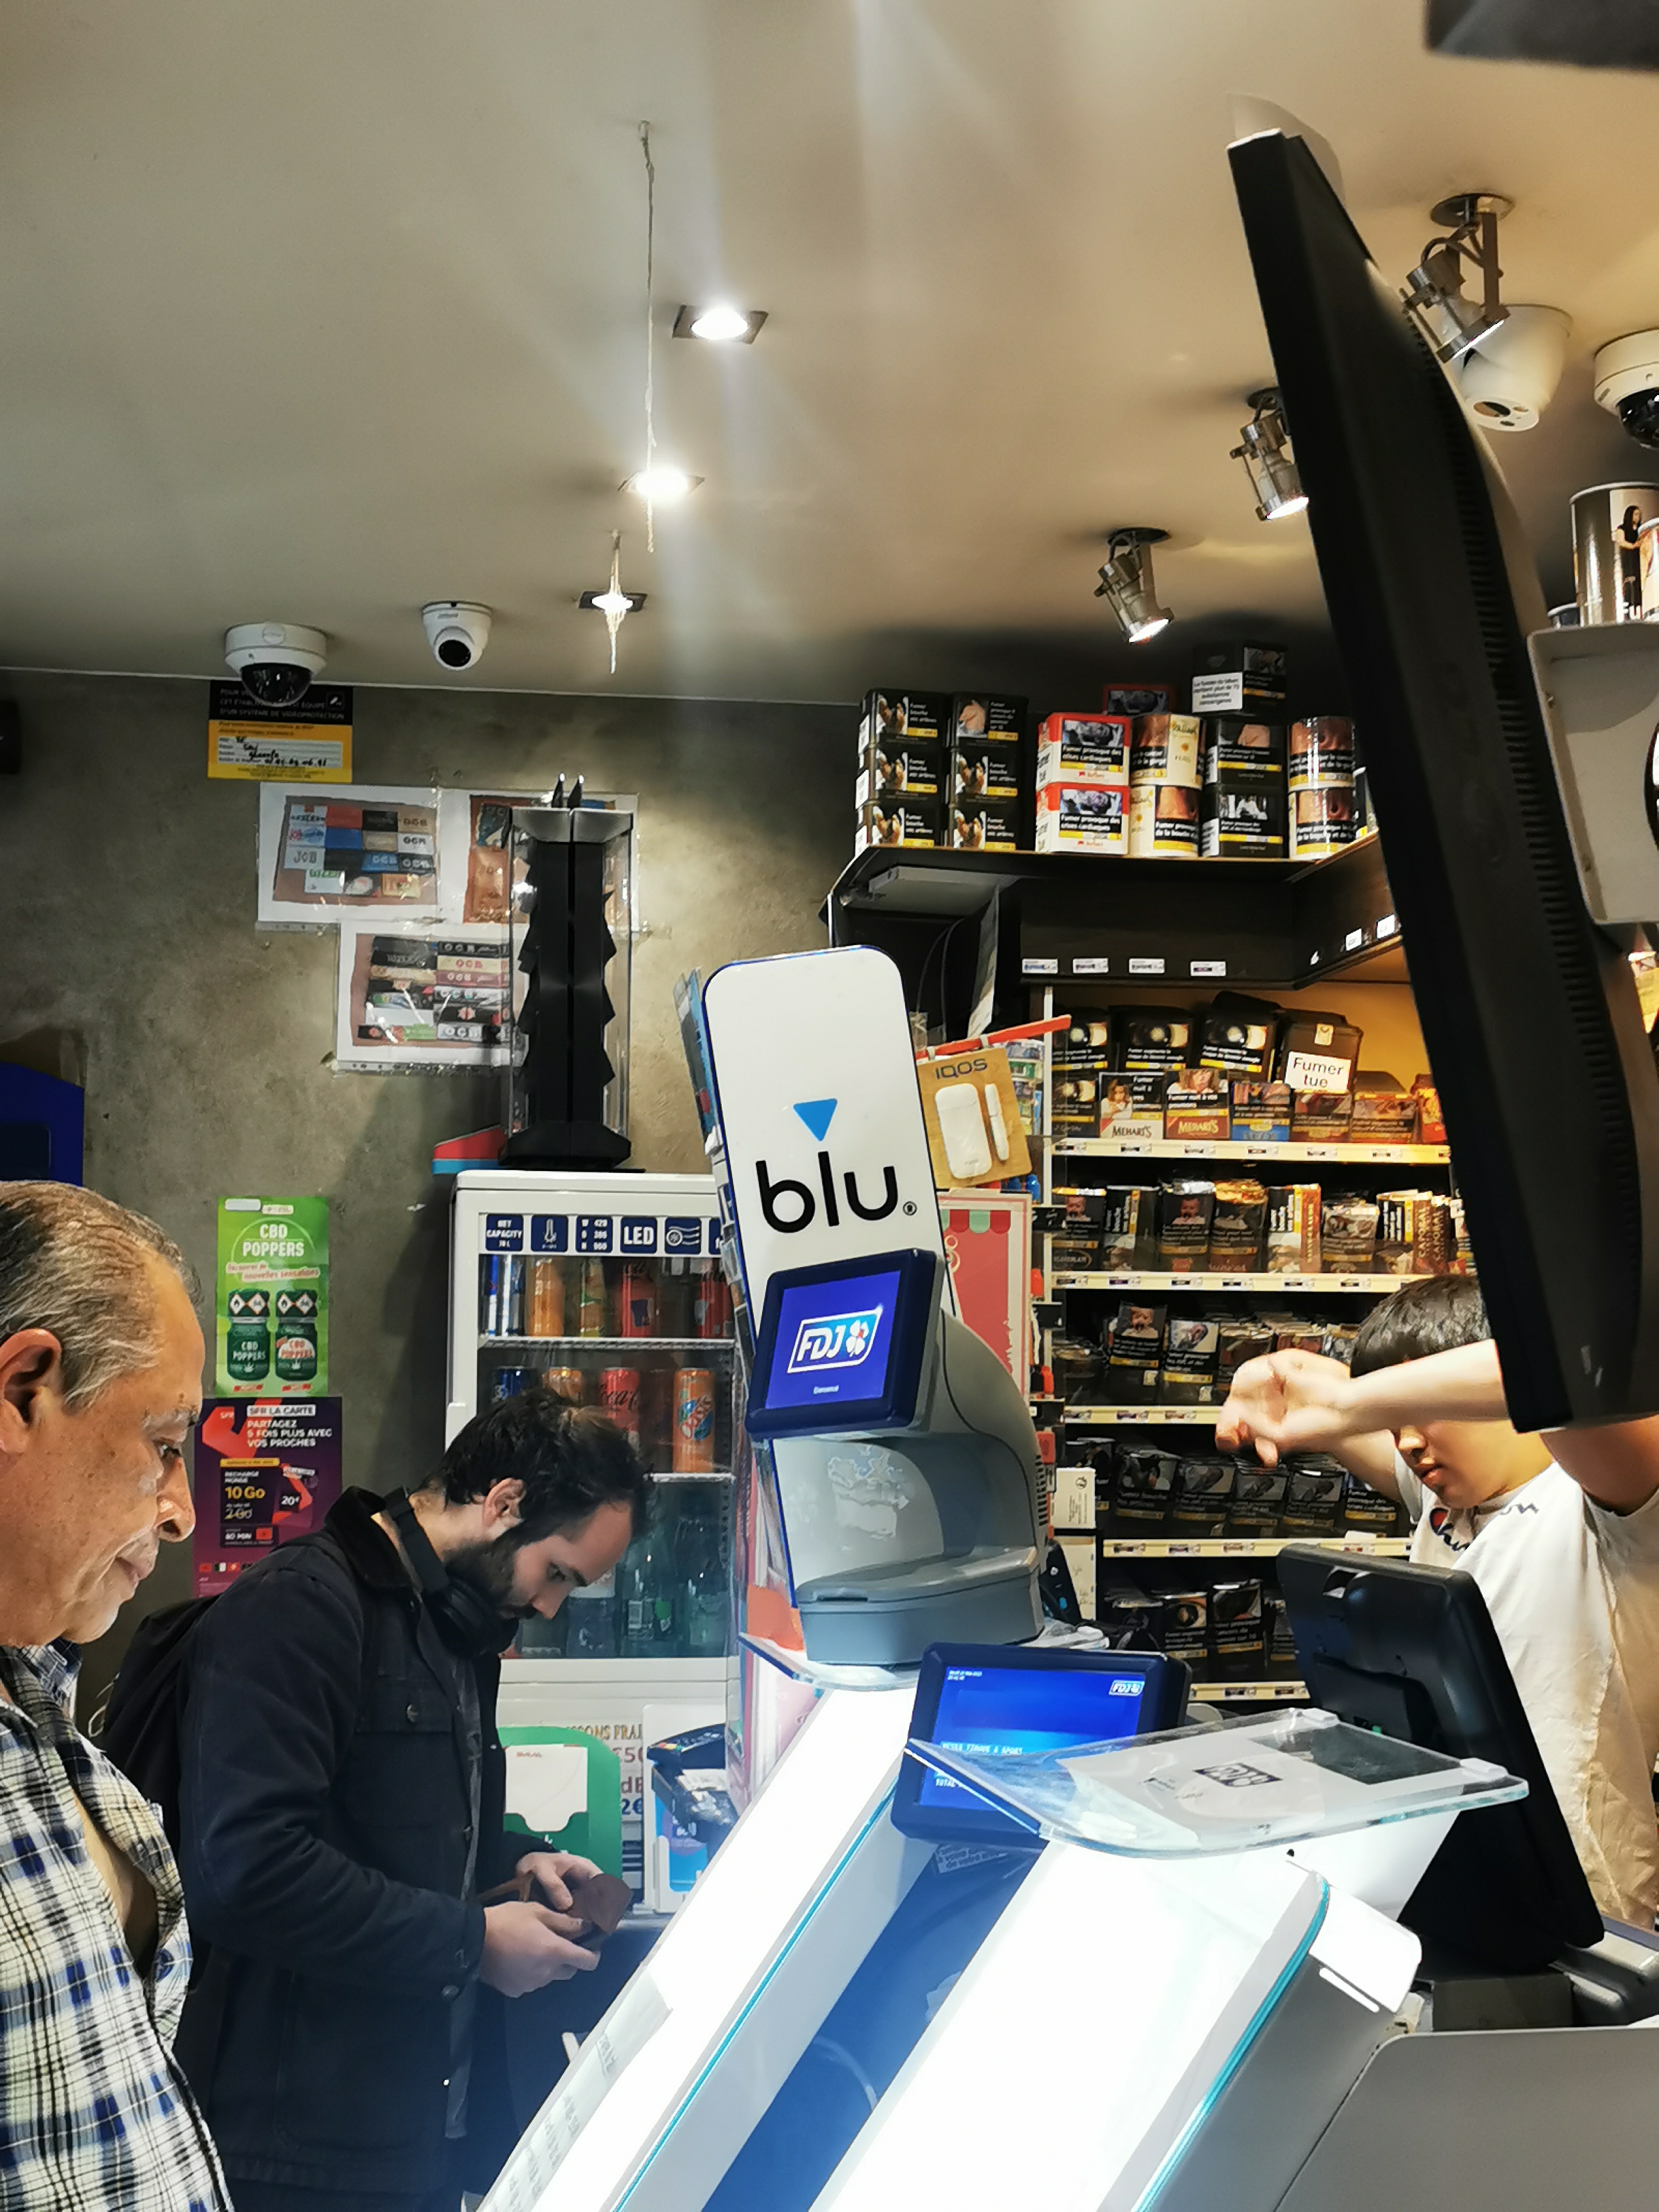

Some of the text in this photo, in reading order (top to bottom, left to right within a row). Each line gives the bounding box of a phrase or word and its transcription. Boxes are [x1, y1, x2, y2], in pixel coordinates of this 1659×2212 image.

[935, 1058, 988, 1080] IQOS
[1293, 1057, 1343, 1076] Fumer
[1303, 1075, 1328, 1088] tue
[260, 1224, 287, 1239] CBD
[486, 1230, 522, 1238] CAPACITY
[623, 1226, 654, 1245] LED
[243, 1242, 304, 1257] POPPERS
[796, 1324, 846, 1362] FDJ
[233, 1350, 266, 1361] POPPERS
[283, 1406, 313, 1415] CARTE
[247, 1419, 297, 1428] PARTAGEZ
[256, 1429, 278, 1438] FOIS
[280, 1429, 305, 1438] PLUS
[307, 1429, 332, 1437] AVEC
[247, 1438, 316, 1447] VOS PROCHES
[225, 1486, 266, 1500] 10 Go
[1112, 1683, 1134, 1694] FDJ
[936, 1778, 956, 1788] TOTAL
